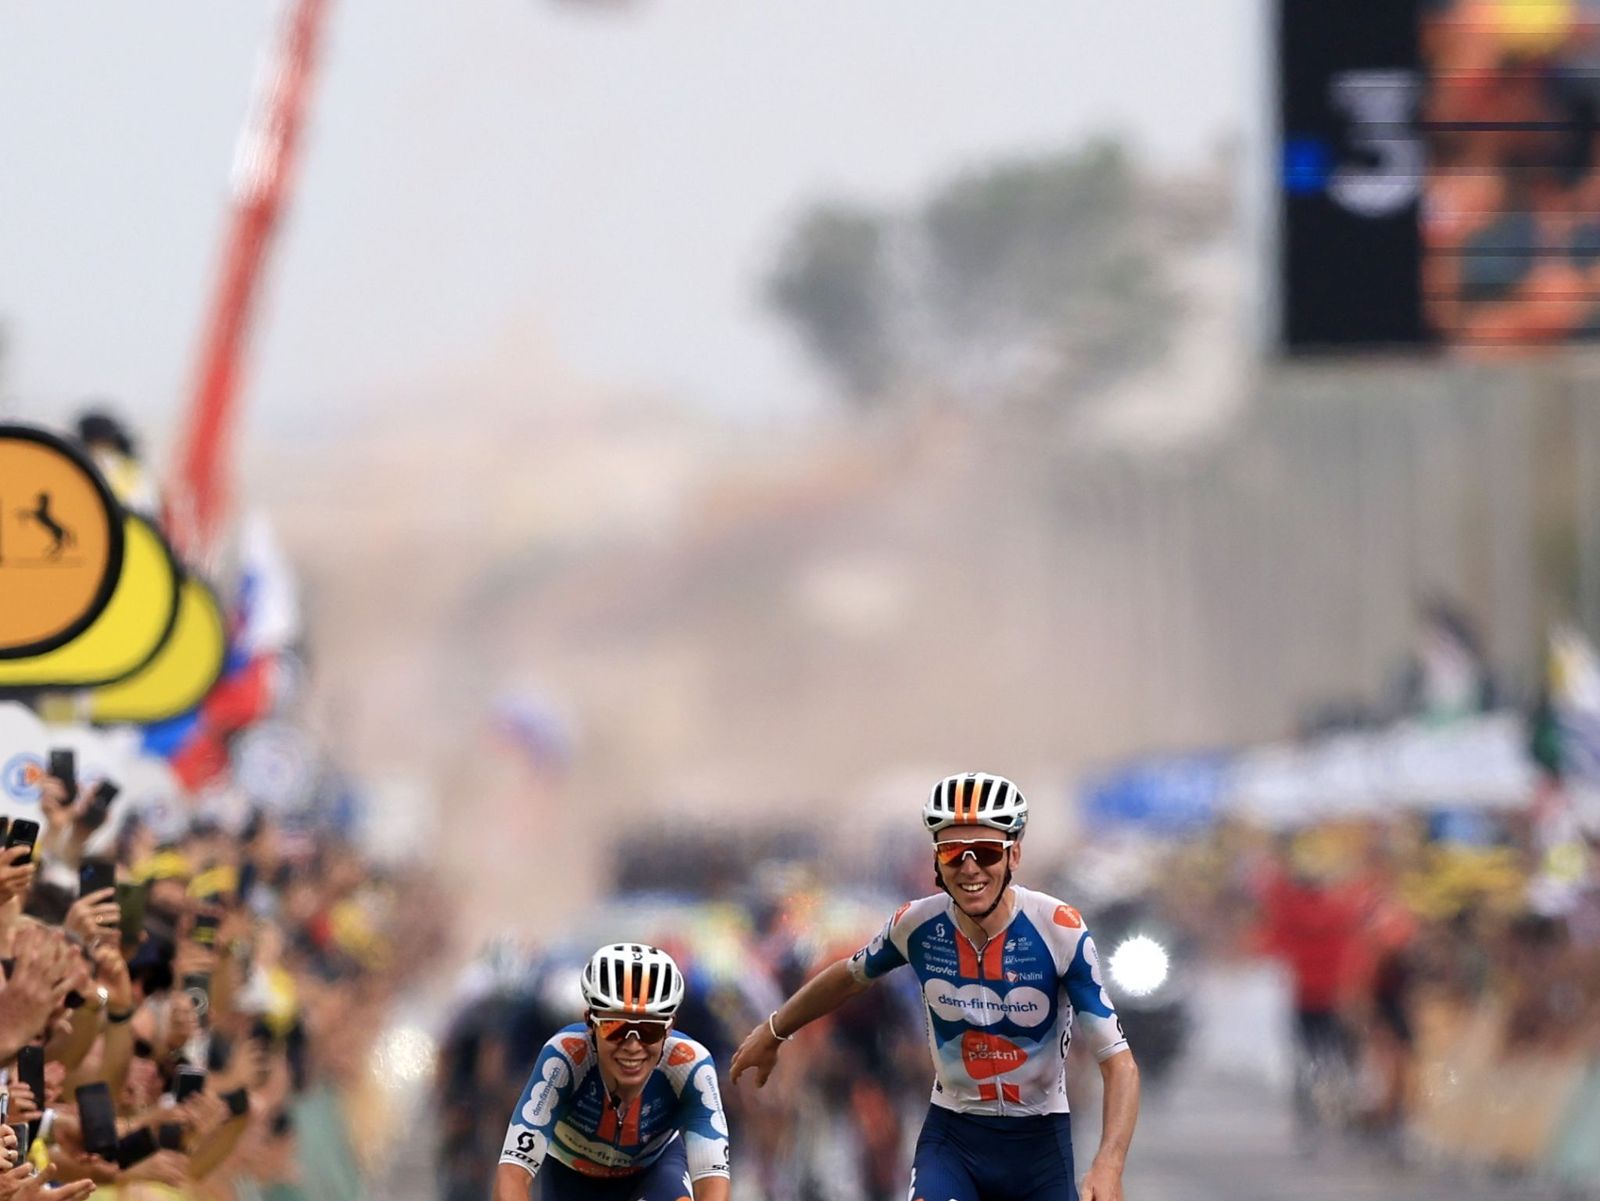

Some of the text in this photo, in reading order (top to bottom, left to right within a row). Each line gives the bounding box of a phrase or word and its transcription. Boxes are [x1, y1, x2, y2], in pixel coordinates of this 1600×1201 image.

[1019, 971, 1043, 981] Nalini
[938, 995, 1038, 1013] dsm-firmenich
[968, 1049, 1019, 1063] postnl
[504, 1149, 540, 1169] SCOTT
